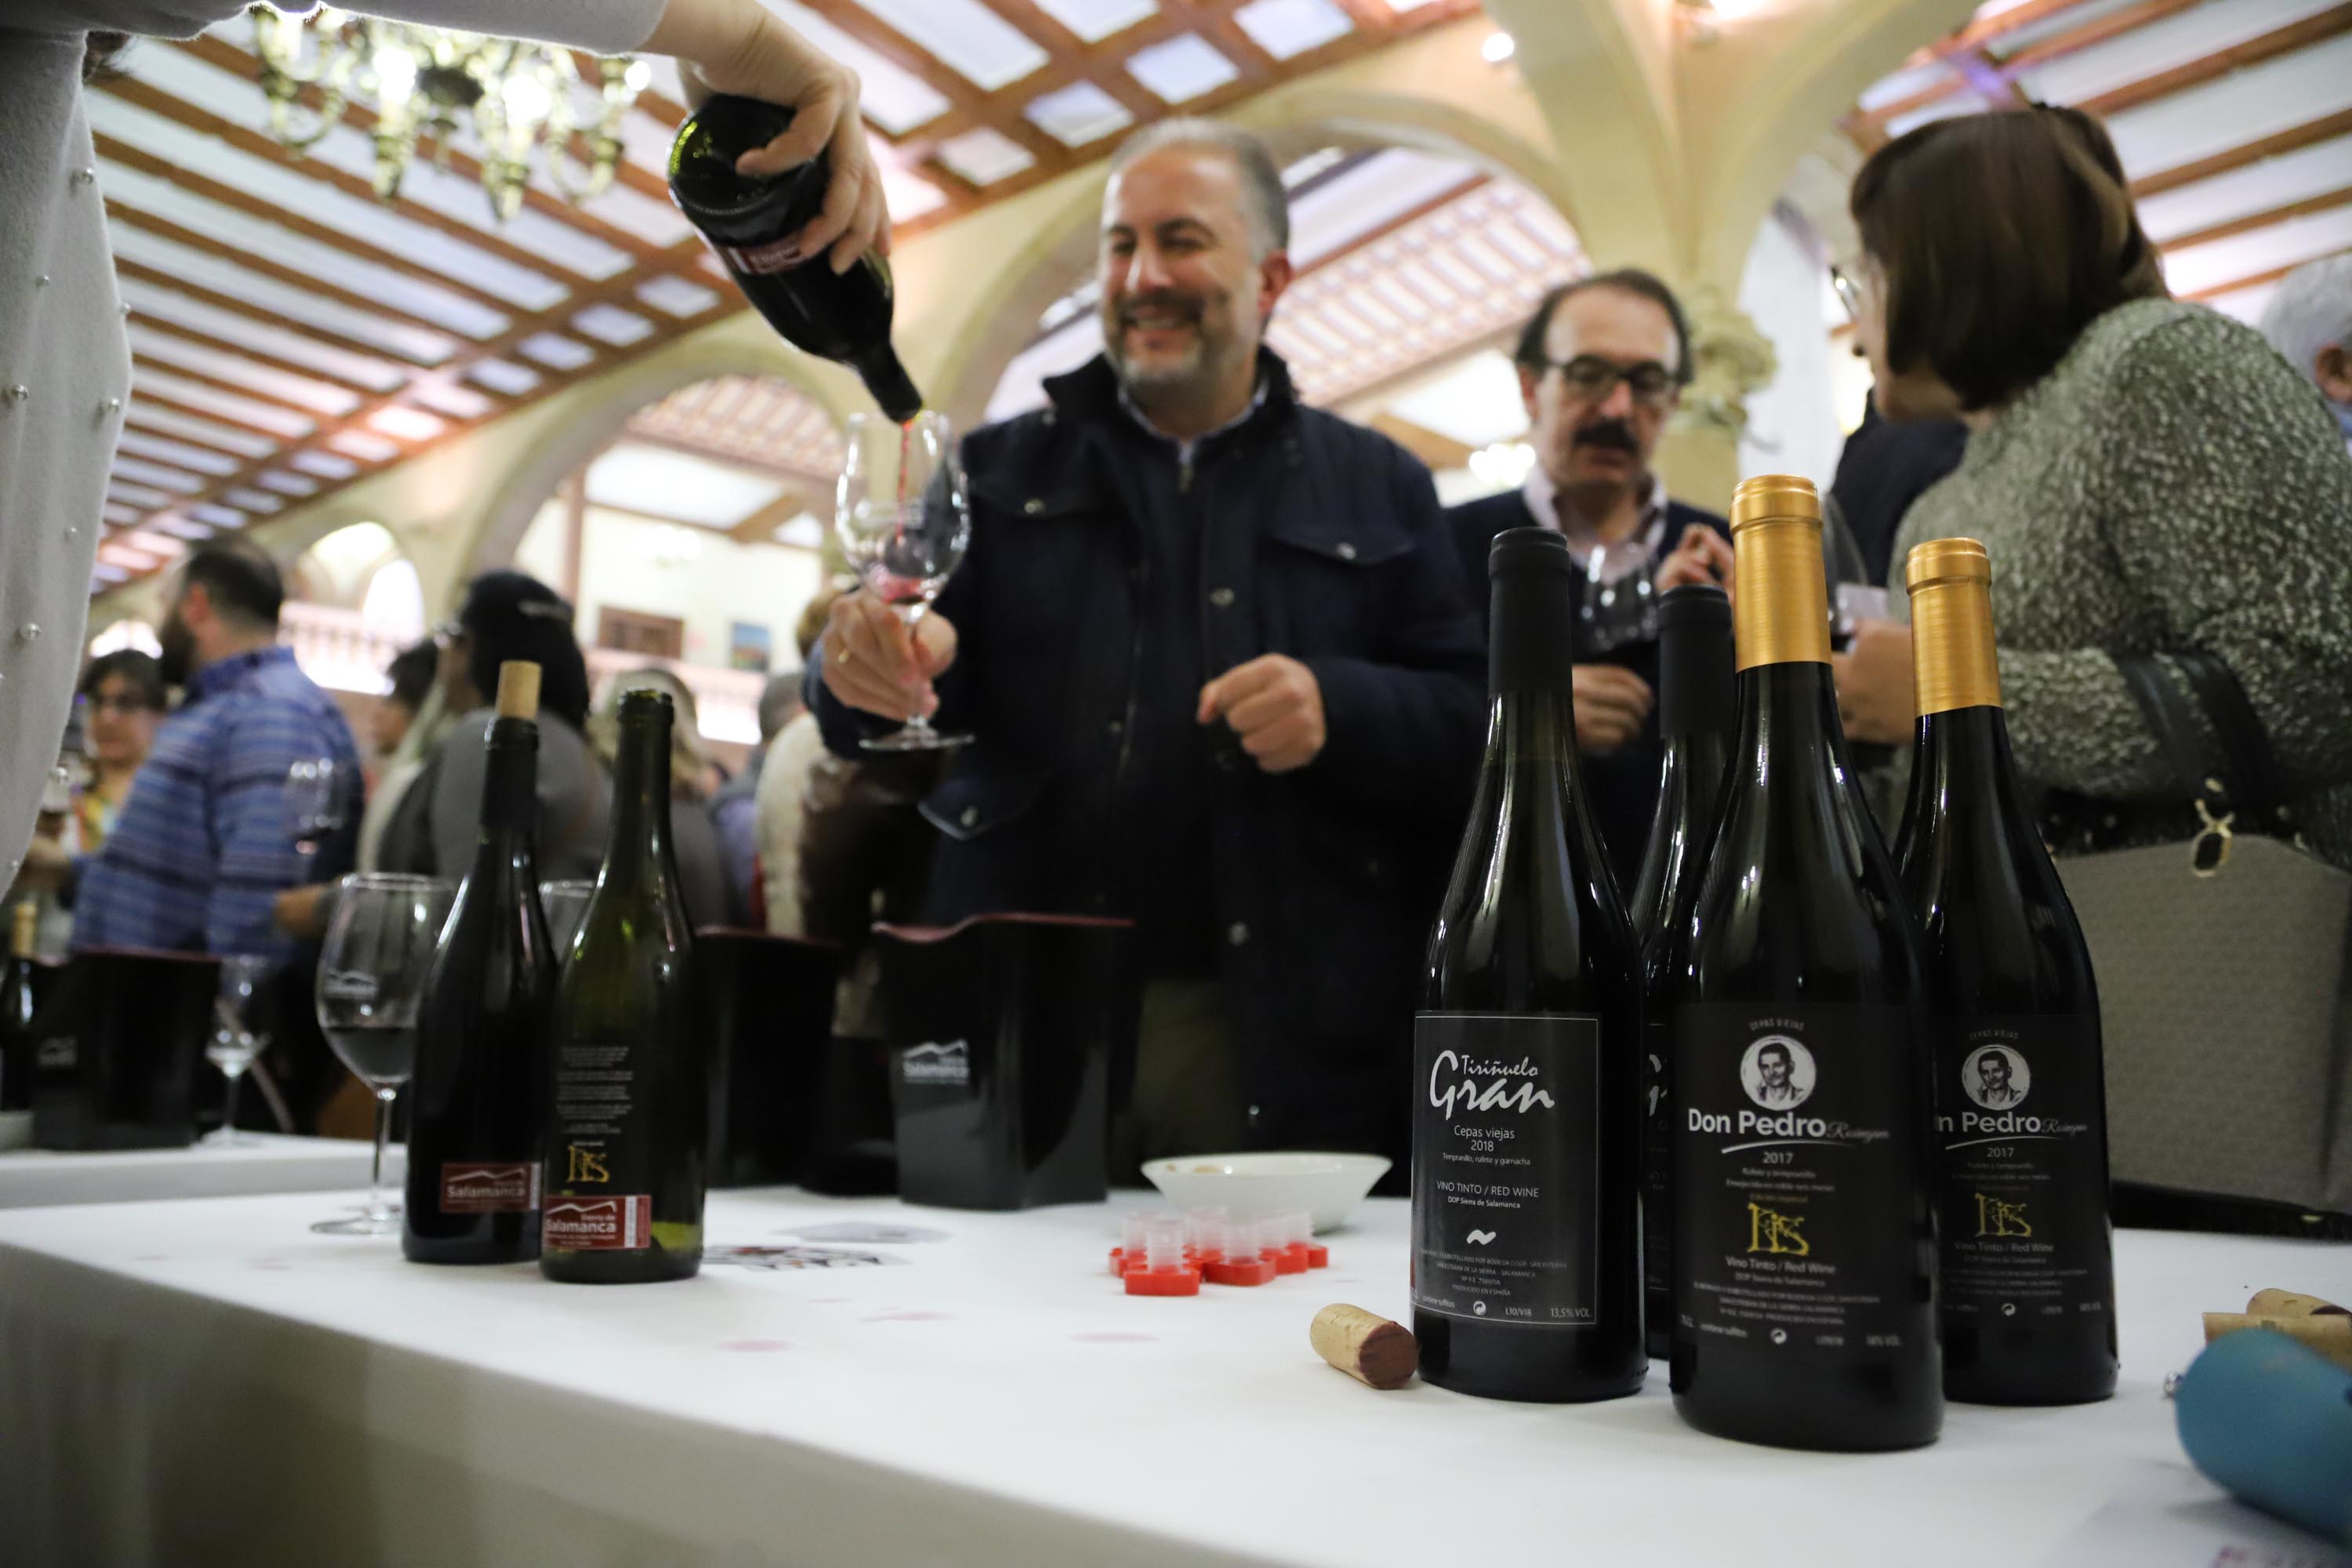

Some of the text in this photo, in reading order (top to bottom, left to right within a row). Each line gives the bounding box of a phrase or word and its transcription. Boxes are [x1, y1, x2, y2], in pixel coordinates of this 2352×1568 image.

[1461, 1054, 1539, 1076] Tiriñuelo
[1430, 1050, 1555, 1121] Gran
[1688, 1108, 1730, 1134] Don
[1738, 1109, 1827, 1138] Pedro
[1962, 1111, 2042, 1133] Pedro
[1454, 1125, 1515, 1142] Cepas viejas
[1471, 1140, 1494, 1152] 2018
[1987, 1147, 2015, 1159] 2017
[1500, 1156, 1530, 1166] garnacha
[1762, 1152, 1794, 1164] 2017
[1437, 1181, 1539, 1197] VINO TINTO / RED WINE
[545, 1219, 616, 1232] Salamanca
[1979, 1242, 2003, 1252] Tinto
[2011, 1243, 2030, 1253] Red
[2031, 1243, 2054, 1252] Wine
[1726, 1256, 1748, 1268] Vino
[1749, 1258, 1776, 1272] Tinto
[1784, 1261, 1806, 1273] Red
[1807, 1262, 1836, 1275] Wine
[1551, 1307, 1573, 1318] 13,5%
